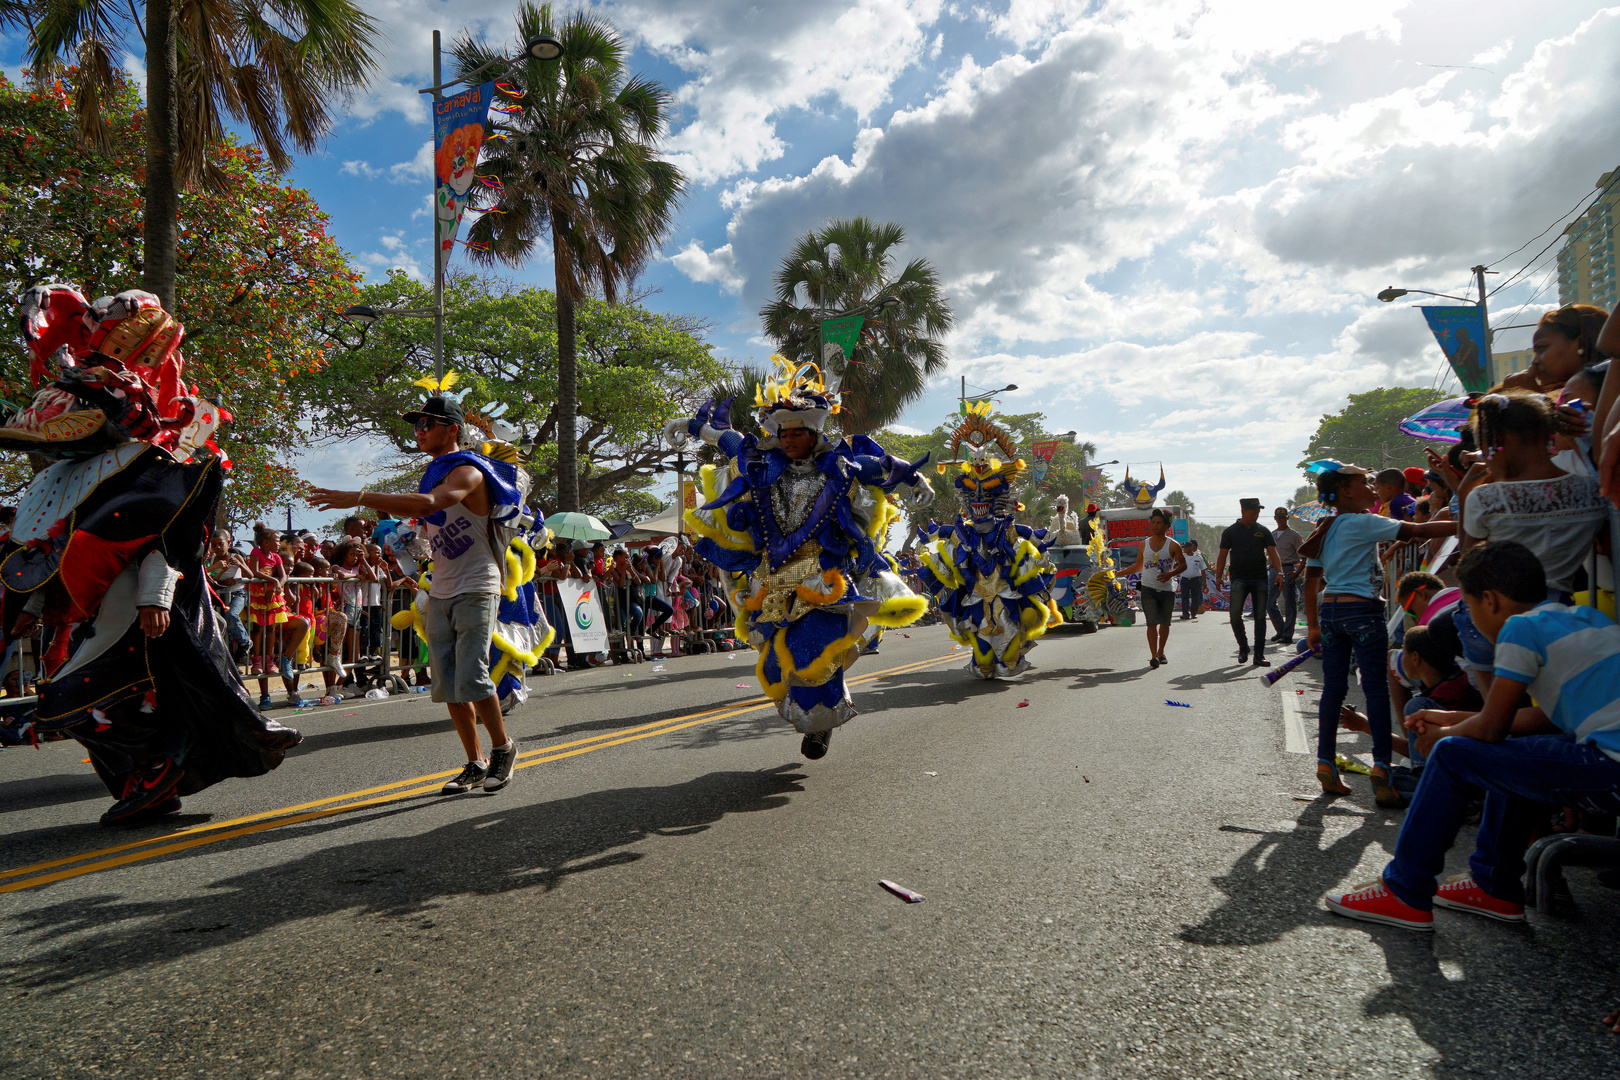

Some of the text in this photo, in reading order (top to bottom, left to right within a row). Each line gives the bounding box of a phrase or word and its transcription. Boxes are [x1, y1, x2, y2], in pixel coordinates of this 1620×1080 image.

[436, 86, 481, 114] Carnaval
[438, 106, 482, 125] Dominicano
[1107, 519, 1150, 530] FERNANDO
